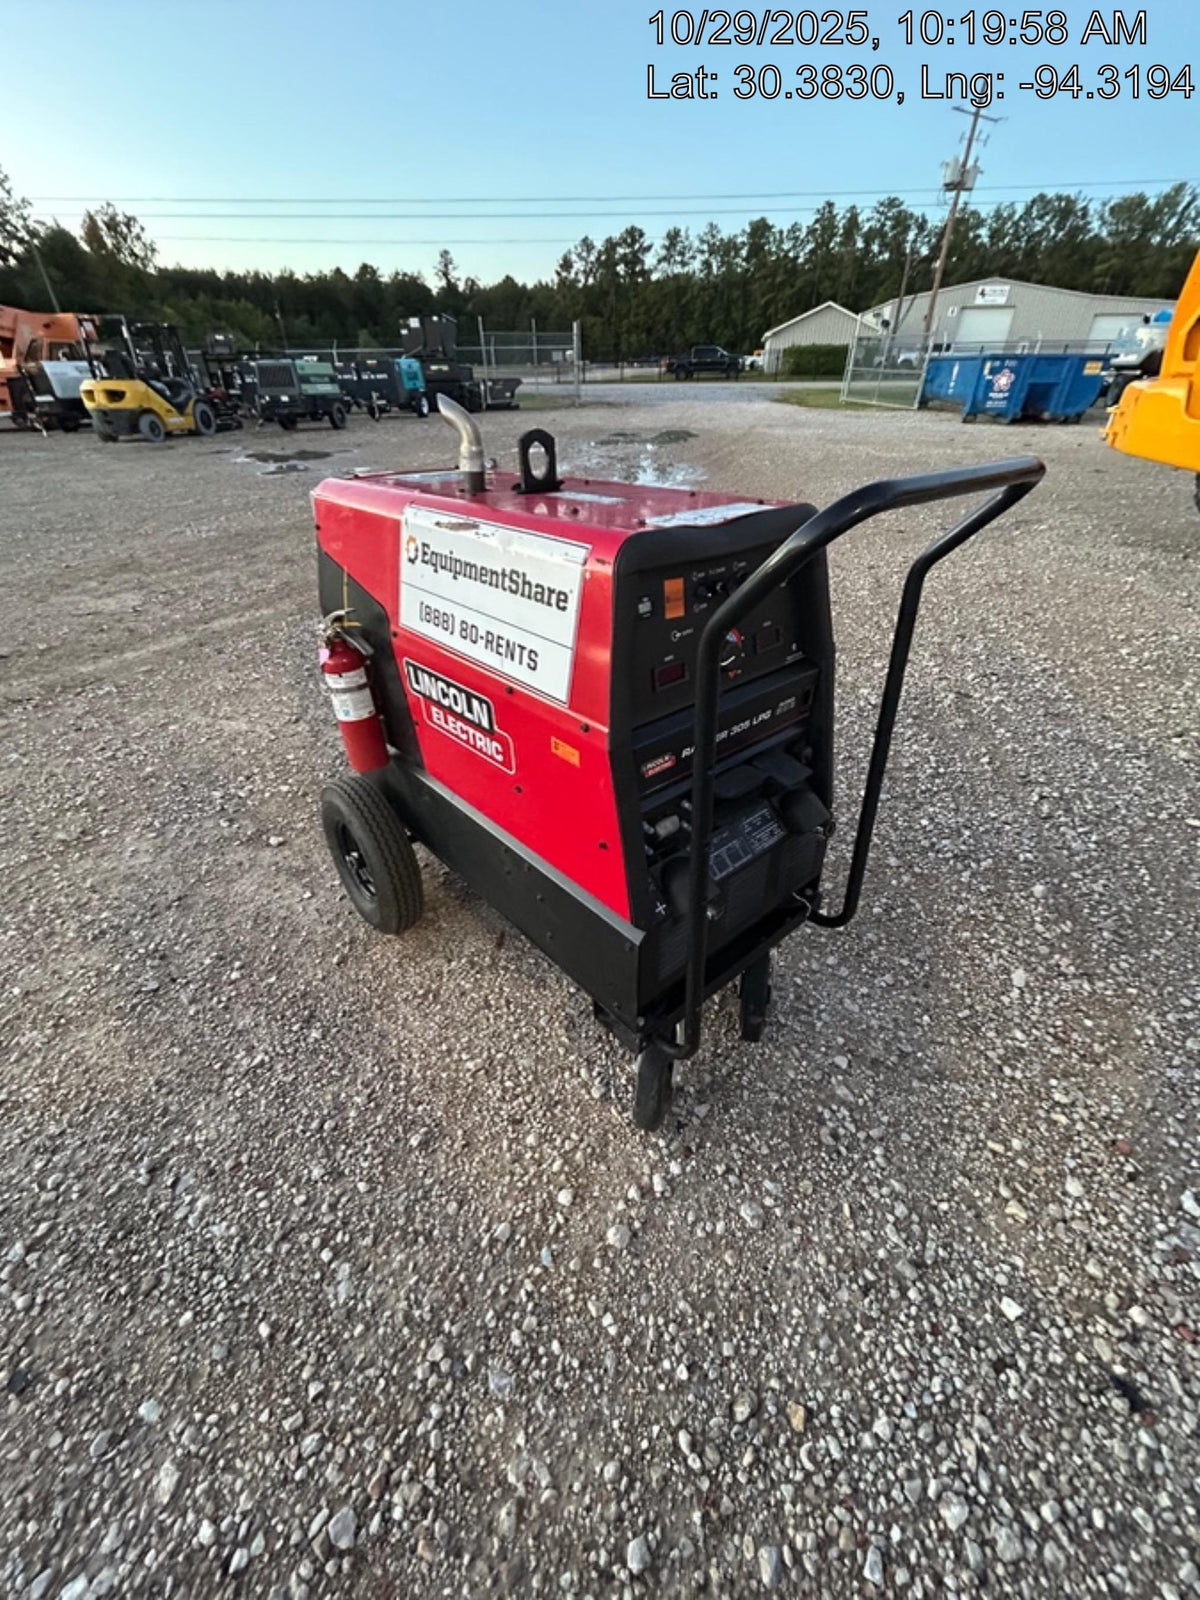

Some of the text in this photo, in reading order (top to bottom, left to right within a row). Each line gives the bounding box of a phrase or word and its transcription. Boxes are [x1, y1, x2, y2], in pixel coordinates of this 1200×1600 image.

[420, 541, 569, 612] EquipmentShare
[419, 600, 539, 672] (888) 80-RENTS
[407, 665, 491, 731] LINCOLN
[431, 705, 504, 762] ELECTRIC
